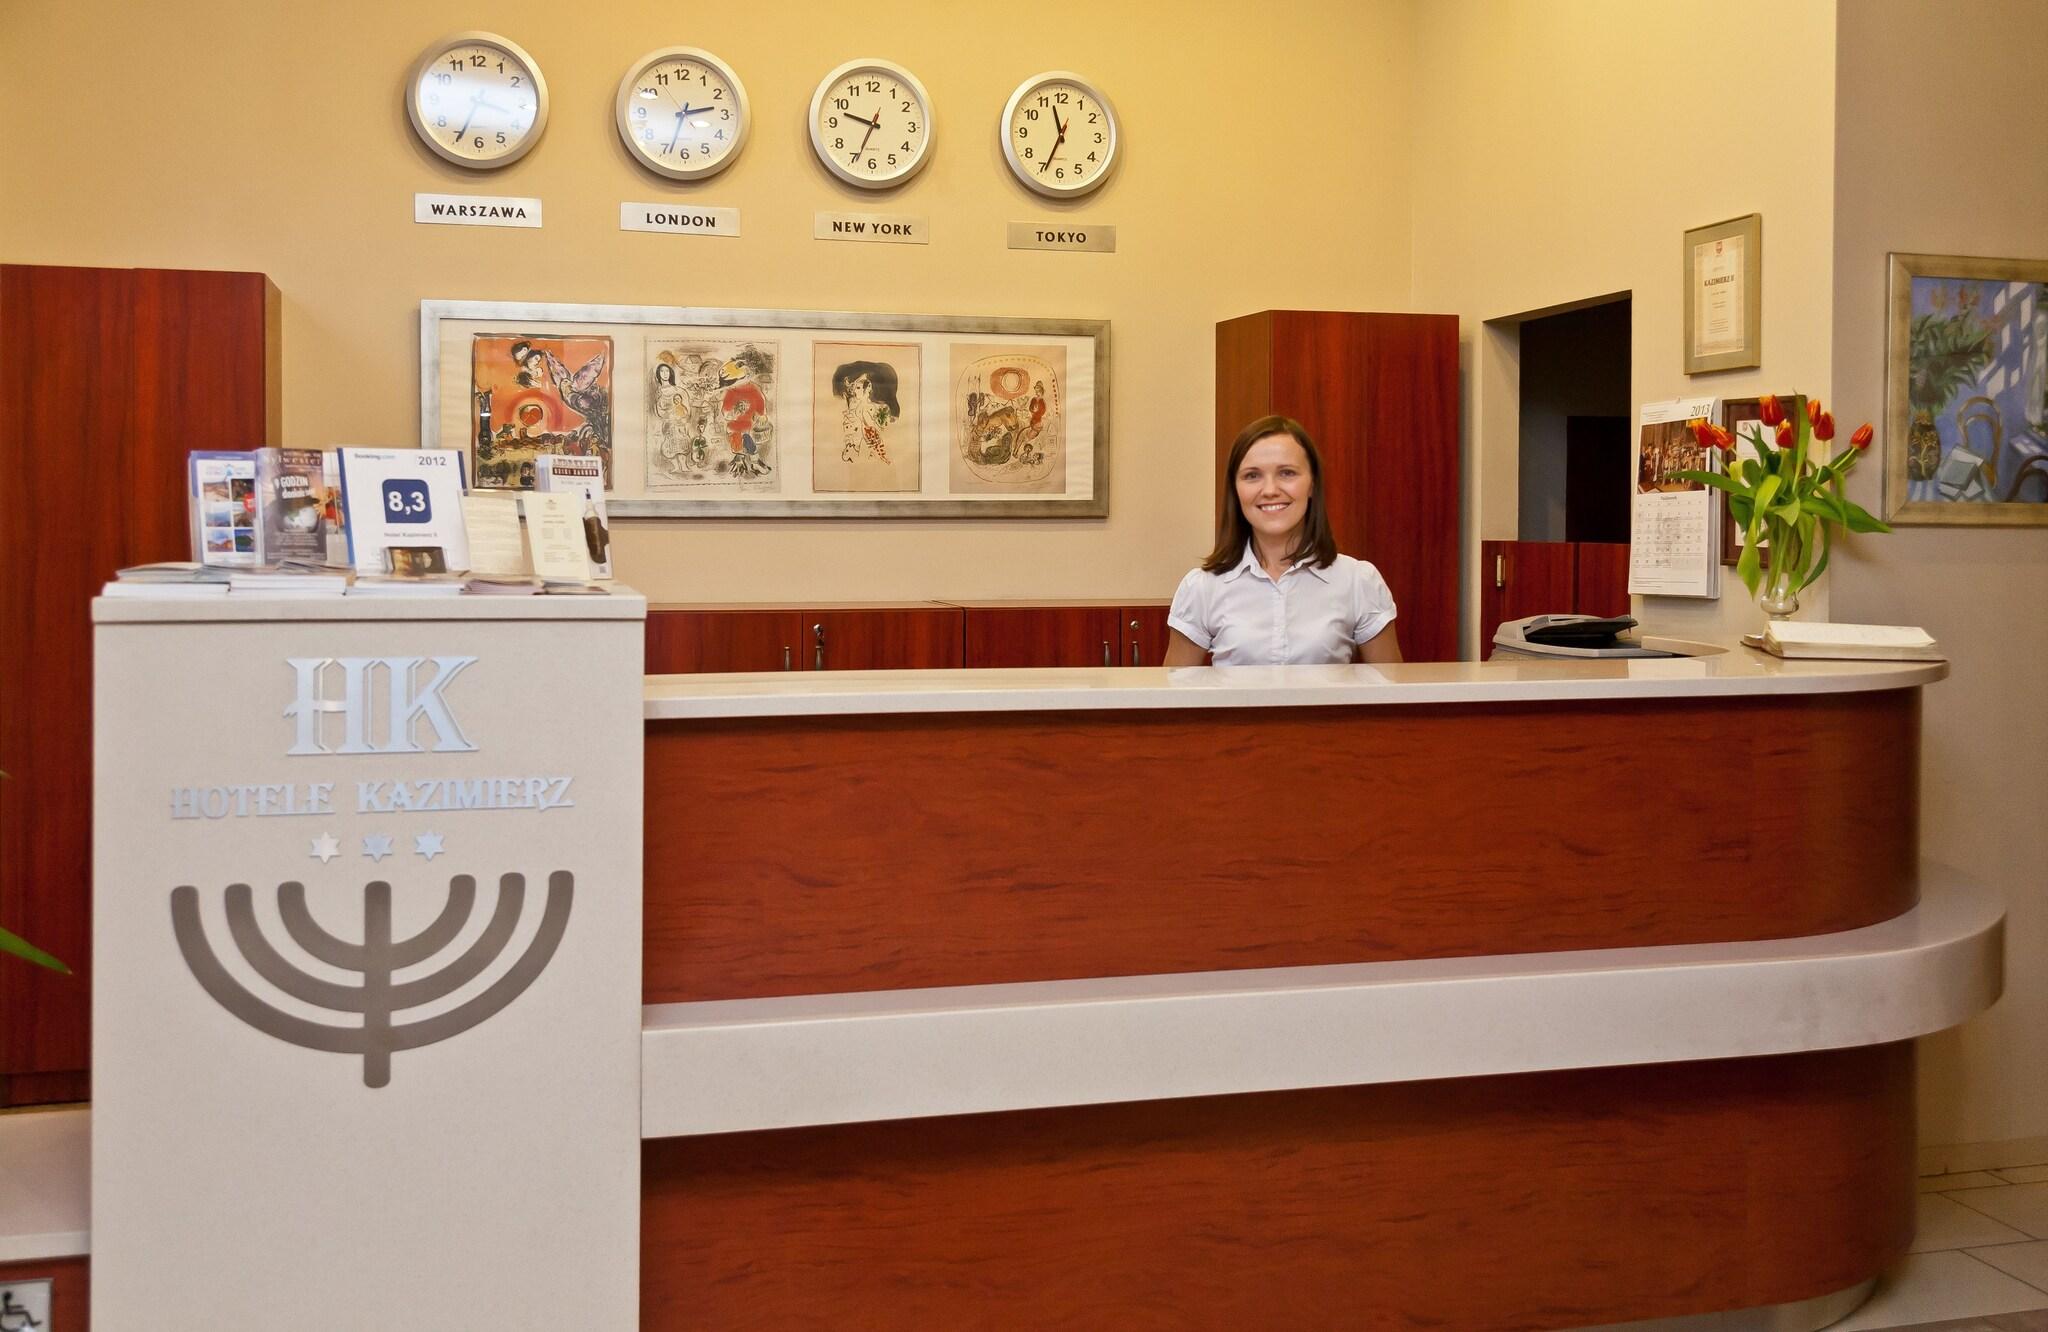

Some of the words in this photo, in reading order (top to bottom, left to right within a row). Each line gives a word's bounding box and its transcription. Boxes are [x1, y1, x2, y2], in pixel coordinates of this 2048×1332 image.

[450, 60, 463, 71] 11
[470, 56, 486, 67] 12
[497, 63, 503, 73] 1
[435, 74, 451, 85] 10
[656, 74, 668, 85] 11
[674, 69, 690, 80] 12
[511, 77, 520, 88] 2
[700, 75, 706, 86] 1
[848, 86, 859, 96] 11
[866, 81, 880, 92] 12
[713, 89, 722, 99] 2
[890, 88, 895, 99] 1
[1055, 93, 1068, 104] 12
[834, 99, 849, 110] 10
[902, 102, 910, 112] 2
[1037, 97, 1048, 107] 11
[1077, 100, 1082, 110] 1
[638, 108, 646, 118] 9
[721, 109, 729, 120] 3
[1024, 110, 1038, 120] 10
[1088, 113, 1096, 123] 2
[438, 116, 447, 127] 8
[829, 117, 837, 128] 9
[908, 122, 916, 132] 3
[453, 131, 463, 142] 7
[496, 132, 505, 143] 5
[645, 129, 654, 140] 8
[714, 129, 723, 140] 4
[1019, 127, 1027, 138] 9
[1094, 133, 1102, 143] 3
[474, 137, 484, 148] 6
[835, 138, 844, 149] 8
[901, 142, 910, 152] 4
[661, 144, 669, 154] 7
[680, 148, 689, 159] 6
[701, 143, 710, 154] 5
[1025, 148, 1033, 158] 8
[850, 153, 859, 163] 7
[888, 154, 896, 164] 5
[1087, 152, 1096, 162] 4
[868, 159, 876, 169] 6
[1038, 162, 1046, 172] 7
[1074, 164, 1082, 174] 5
[1056, 168, 1064, 178] 6
[431, 204, 527, 219] WARSZAWA
[646, 213, 716, 227] LONDON
[833, 221, 865, 234] NEW
[872, 223, 912, 235] YORK
[1036, 232, 1087, 243] TOKYO
[1691, 404, 1710, 416] 2013
[418, 456, 446, 466] 2012
[388, 491, 426, 515] 8,3
[283, 656, 481, 756] HK
[170, 783, 336, 820] HOTELE
[355, 776, 576, 814] KAZIMIERZ
